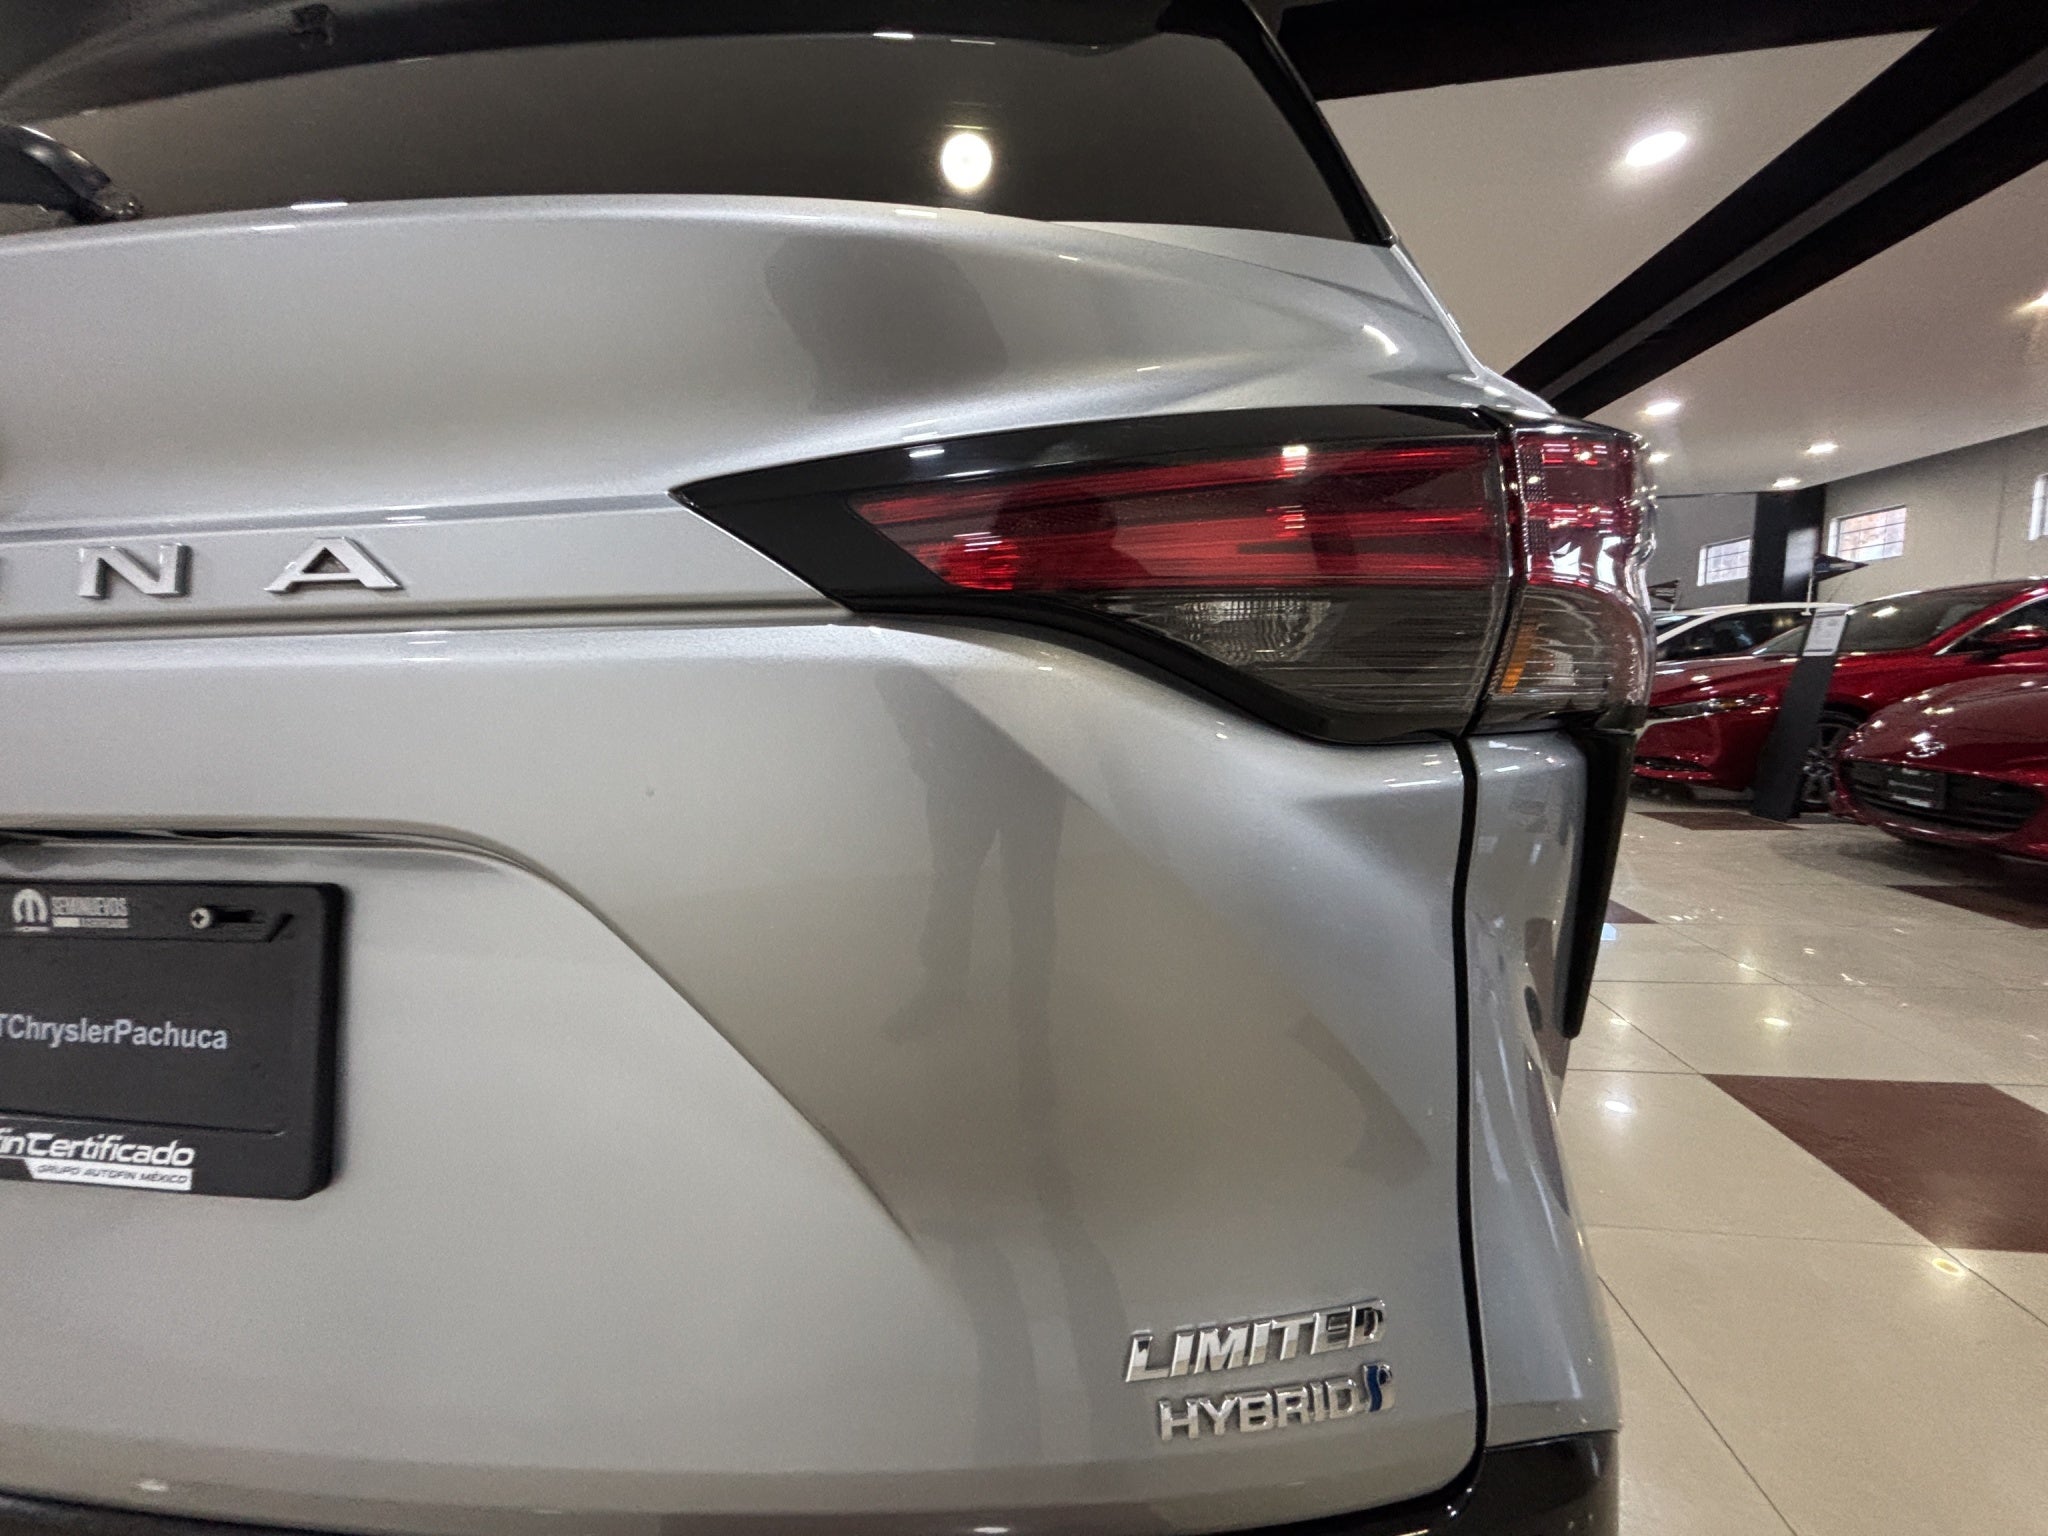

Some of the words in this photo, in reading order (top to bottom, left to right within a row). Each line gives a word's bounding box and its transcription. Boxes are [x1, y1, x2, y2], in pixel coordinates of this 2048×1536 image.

[37, 1164, 81, 1175] GRUPO
[84, 1168, 136, 1180] AUTOFIN
[1125, 1299, 1386, 1383] LIMITED
[1158, 1378, 1363, 1441] HYBRID
